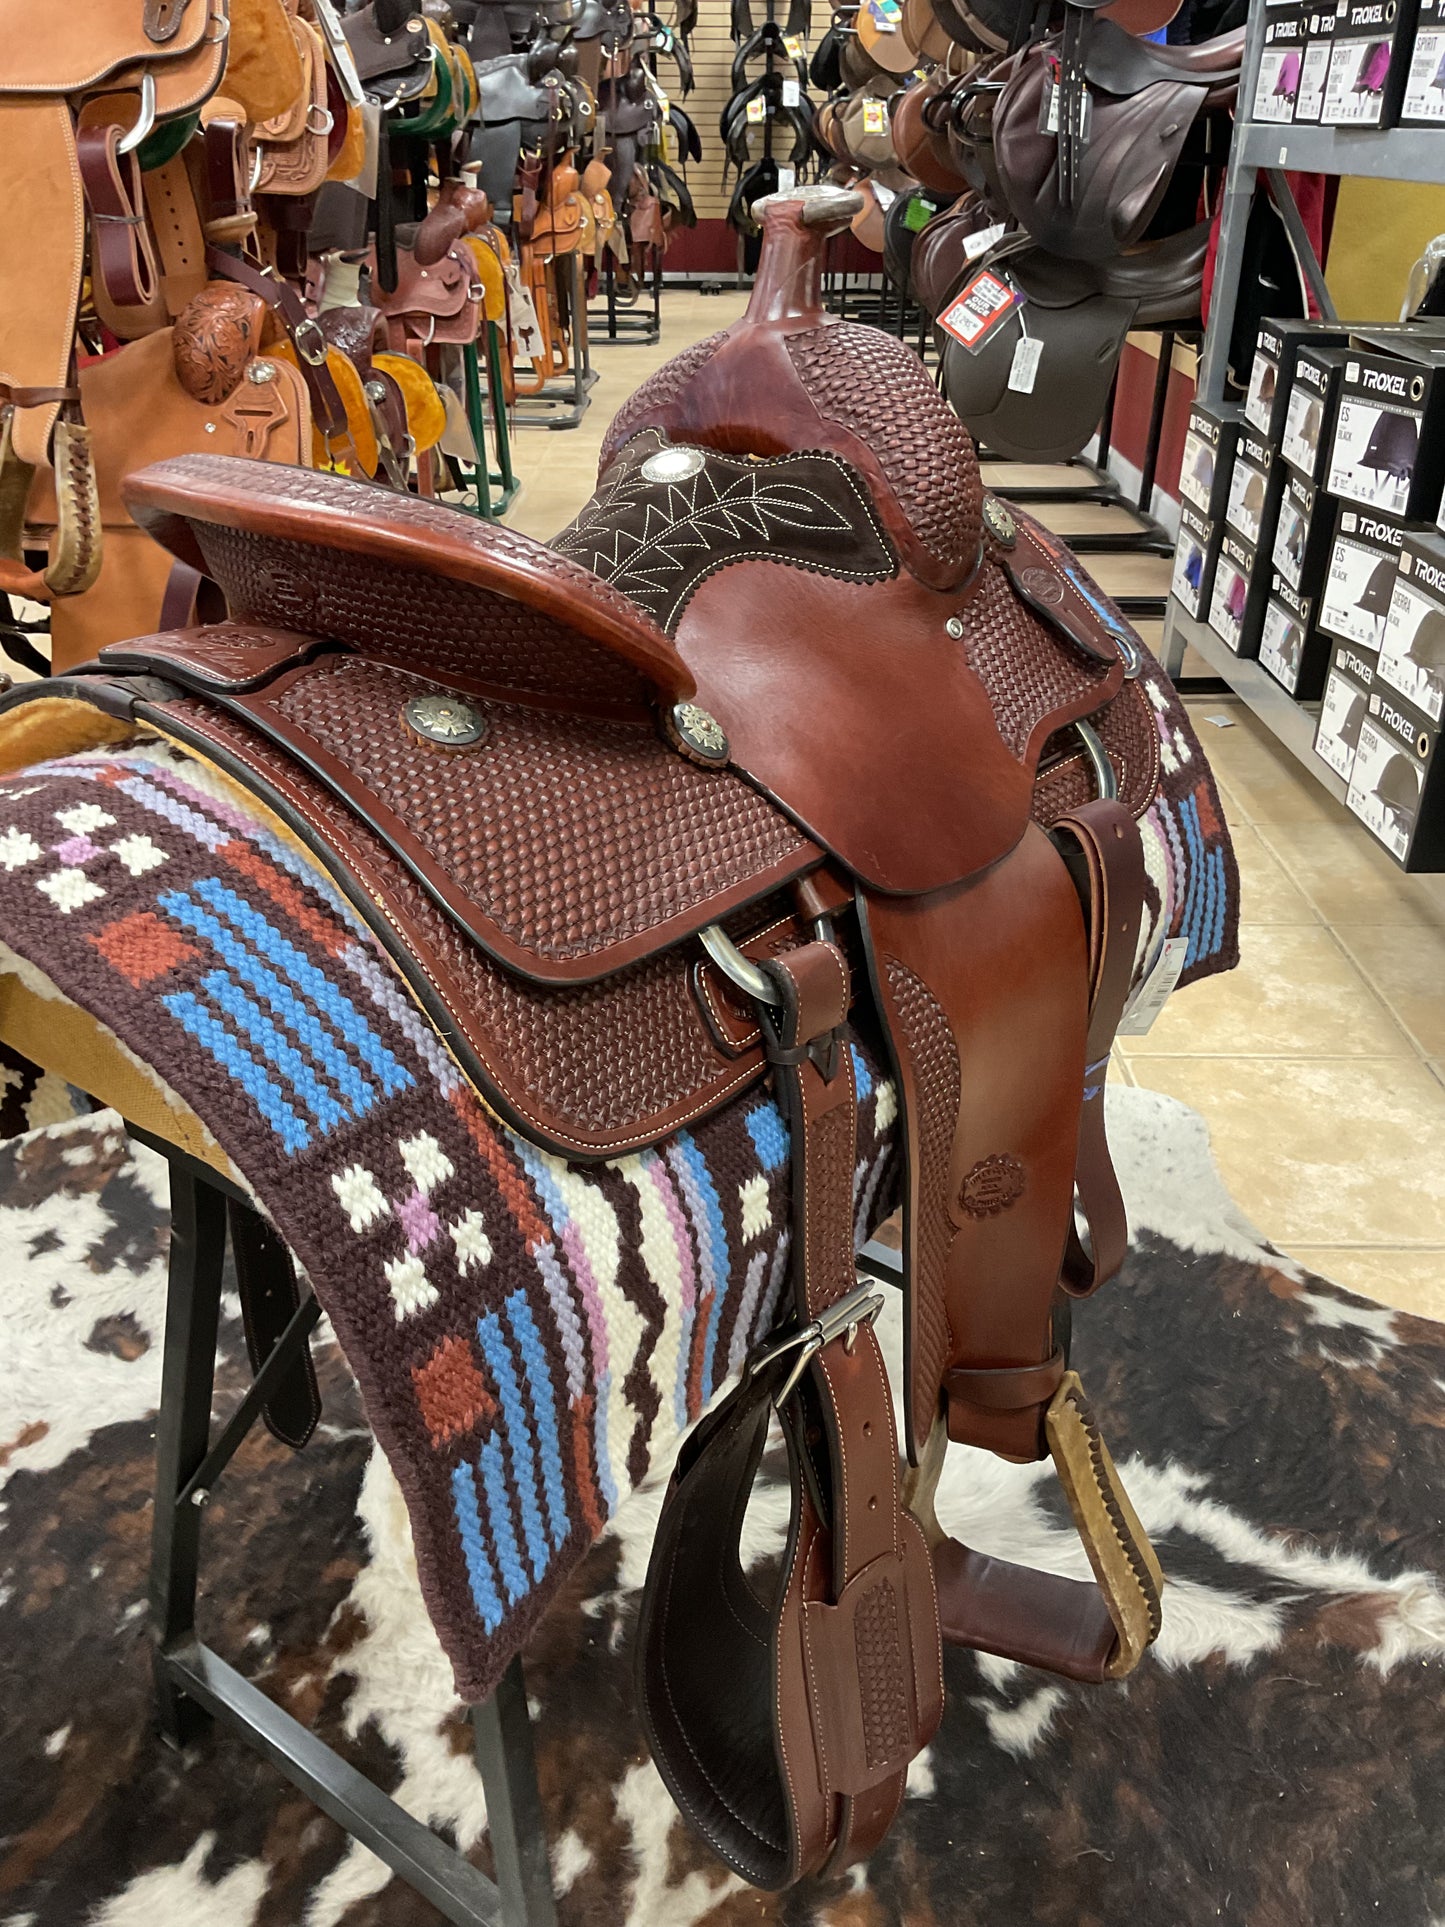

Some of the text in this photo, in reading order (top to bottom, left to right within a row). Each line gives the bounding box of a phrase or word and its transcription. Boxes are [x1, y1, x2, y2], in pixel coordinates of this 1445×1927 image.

[1351, 4, 1383, 25] TROXEL
[1275, 21, 1298, 38] TROXEL
[1332, 49, 1352, 66] SPIRIT
[964, 299, 990, 317] PRICE
[971, 296, 991, 310] OUR
[1263, 332, 1277, 353] TROXEL
[1303, 361, 1321, 386] TROXEL
[1362, 369, 1406, 396] TROXEL
[1341, 406, 1351, 422] ES
[1195, 416, 1212, 439] TROXEL
[1338, 429, 1352, 442] BLACK
[1245, 438, 1263, 462] TROXEL
[1292, 477, 1307, 504] TROXEL
[1335, 546, 1346, 562] ES
[1331, 568, 1348, 582] BLACK
[1279, 582, 1299, 612] TROXEL
[1393, 589, 1411, 614] SIERRA
[1345, 650, 1373, 686] TROXEL
[1380, 702, 1415, 744] TROXEL
[1361, 727, 1378, 753] SIERRA
